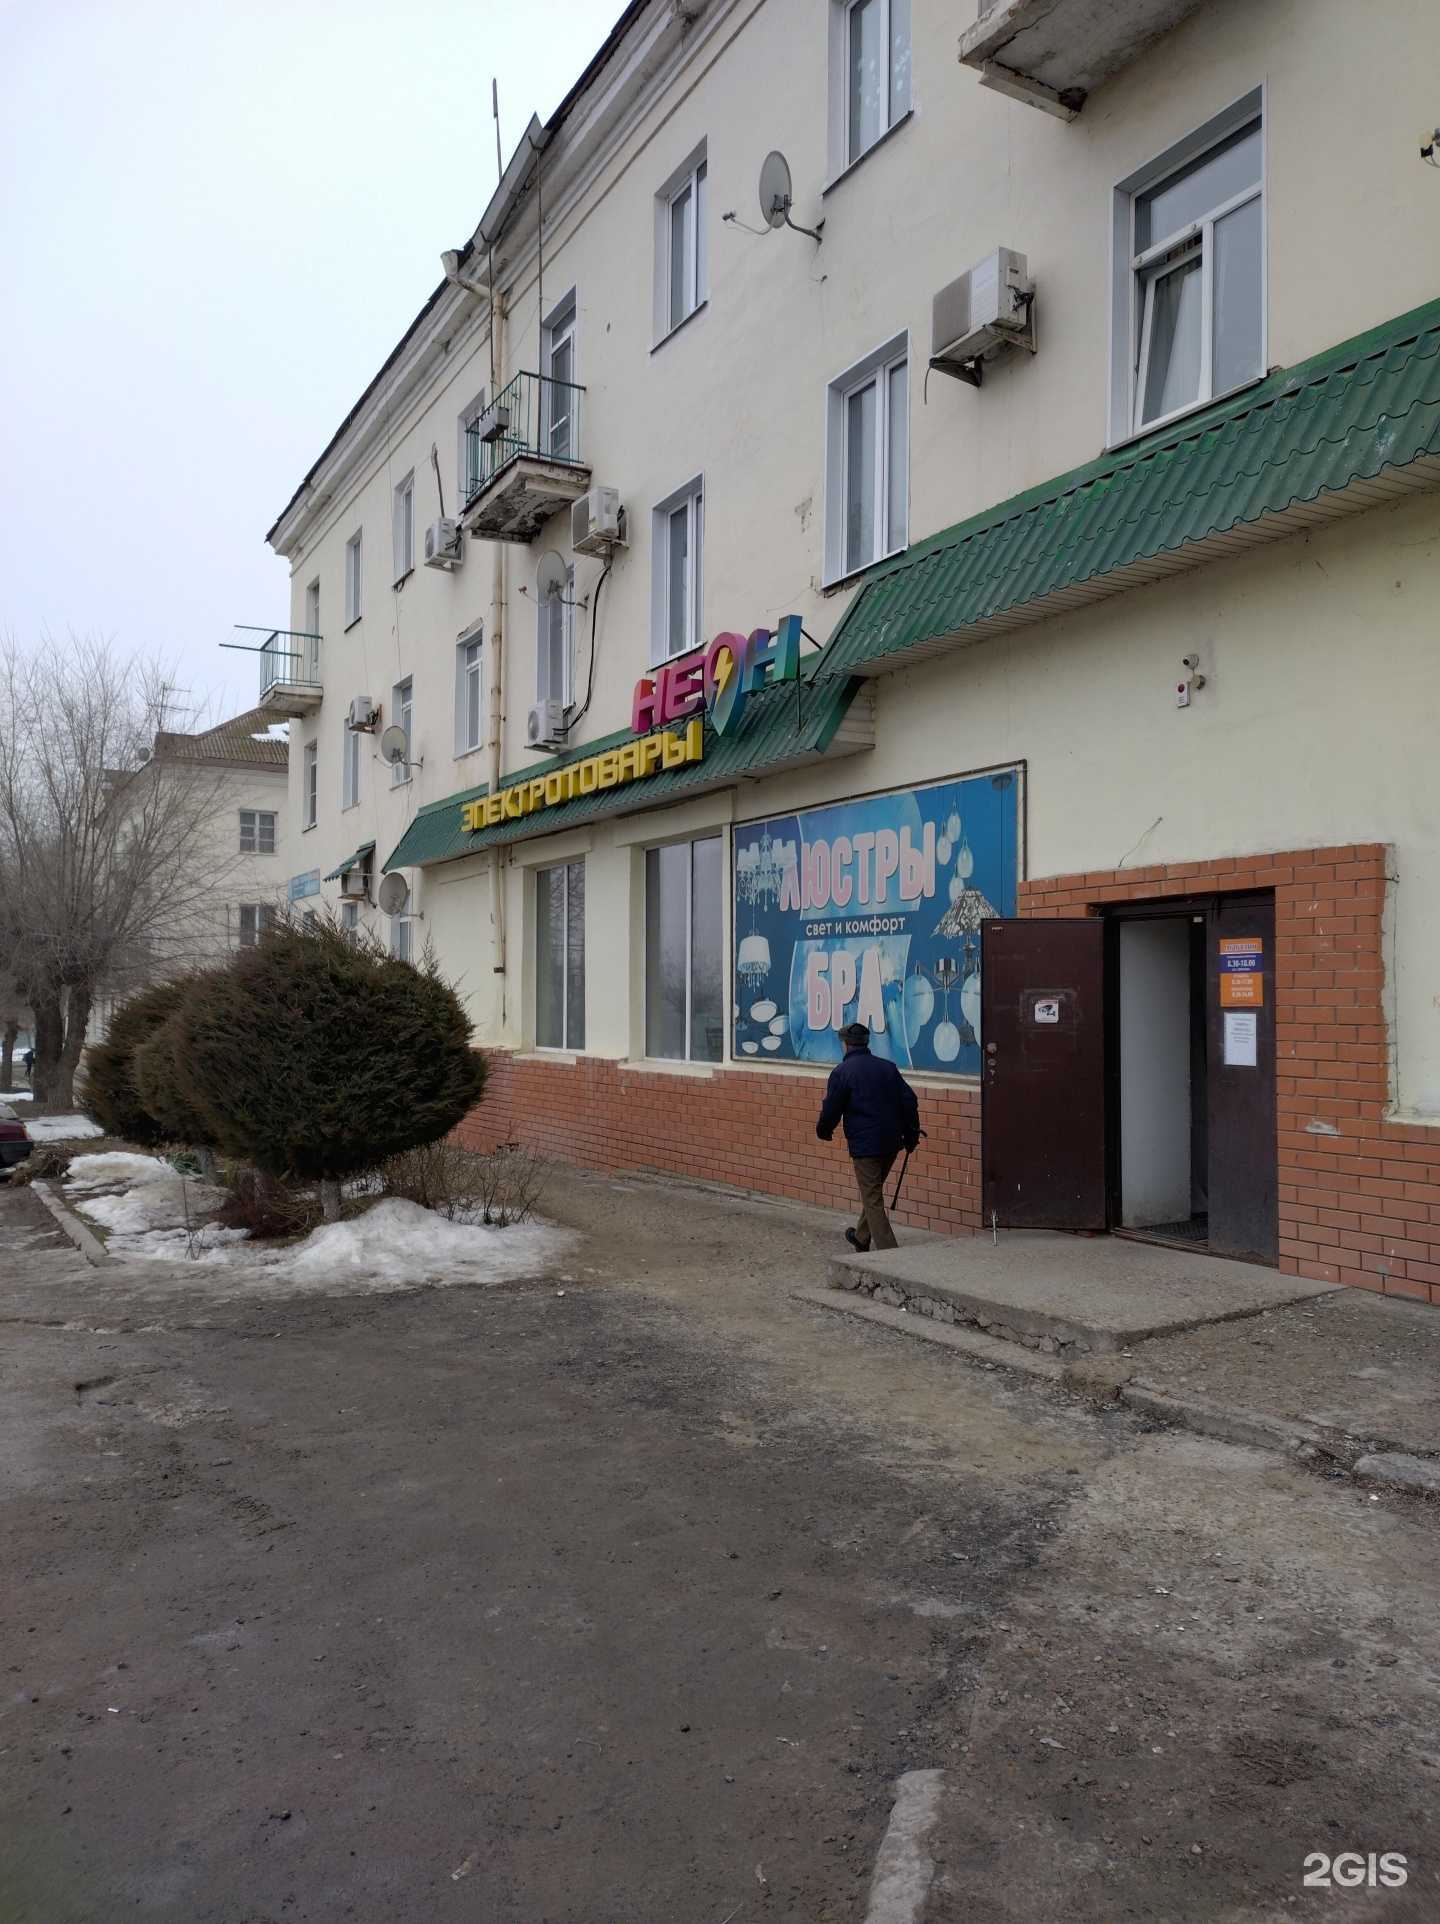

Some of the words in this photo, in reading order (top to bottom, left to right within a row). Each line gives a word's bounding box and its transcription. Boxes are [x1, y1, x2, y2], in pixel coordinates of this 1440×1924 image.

[631, 614, 803, 736] НЕОН
[460, 720, 704, 832] ЭЛЕКТРОТОВАРЫ
[778, 821, 936, 912] ЛЮСТРЫ
[806, 922, 832, 936] свет
[835, 922, 842, 934] и
[845, 915, 906, 935] комфорт
[807, 950, 886, 1033] БРА
